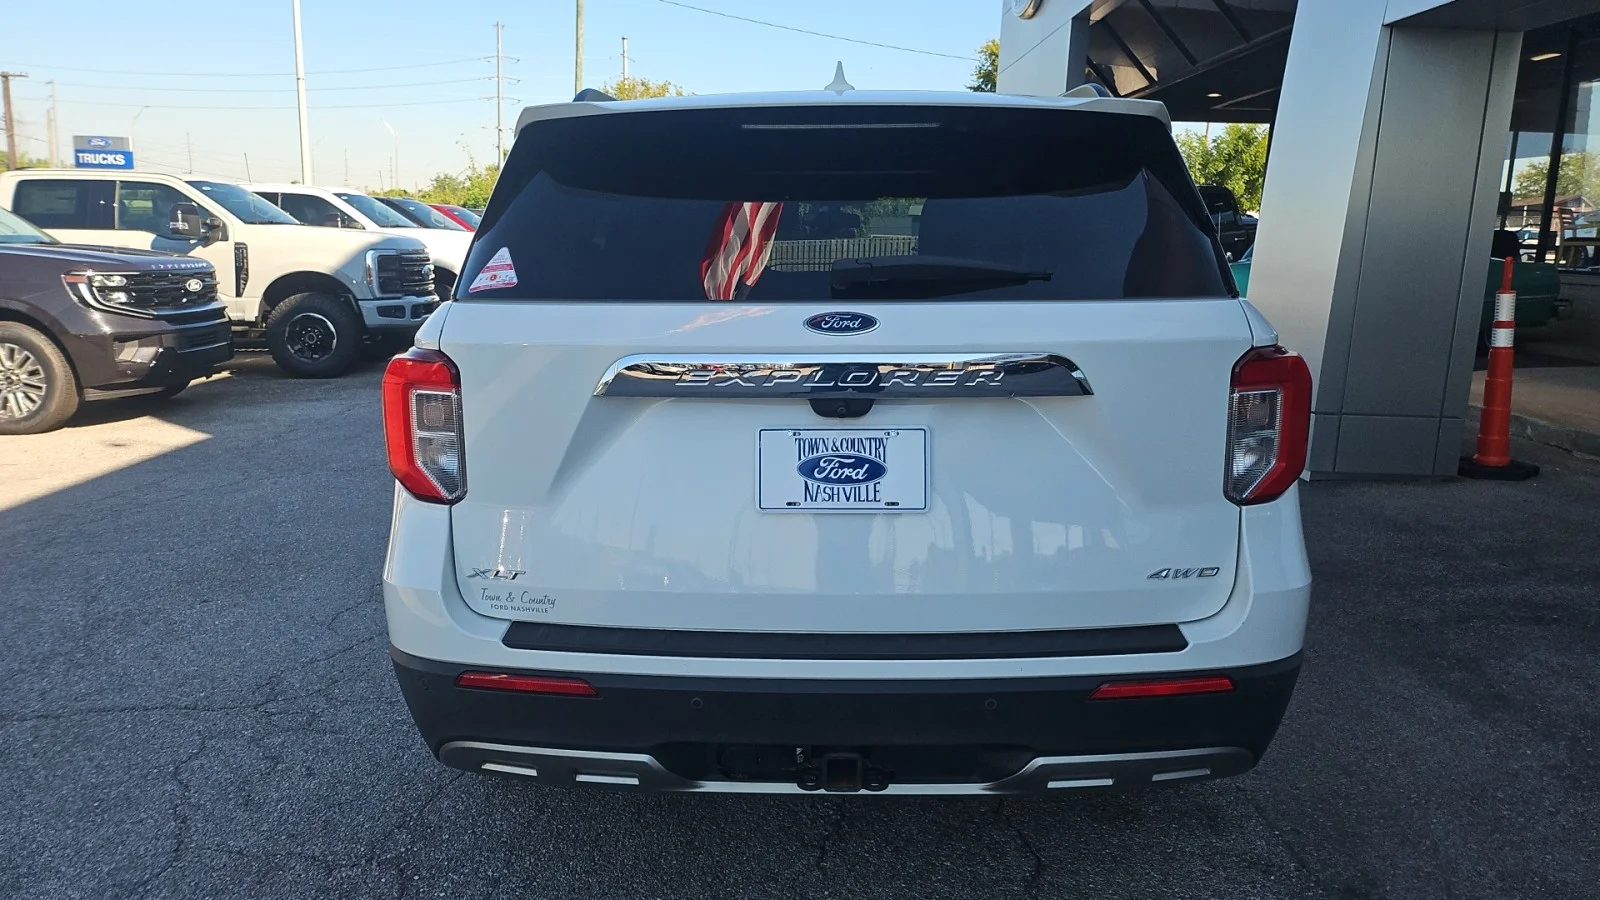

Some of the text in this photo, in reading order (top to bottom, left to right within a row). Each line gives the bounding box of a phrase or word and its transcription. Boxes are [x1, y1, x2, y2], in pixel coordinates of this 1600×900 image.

[77, 153, 126, 166] TRUCKS
[821, 314, 861, 329] Ford
[674, 369, 1006, 387] EXPLORER
[795, 437, 889, 463] TOWN & COUNTRY
[813, 456, 870, 480] Ford
[803, 480, 881, 503] NASHVILLE
[466, 567, 527, 580] XLT
[1147, 566, 1220, 579] 4WD
[481, 587, 557, 609] Town & Country
[490, 603, 549, 614] FORD NASHVILLE
